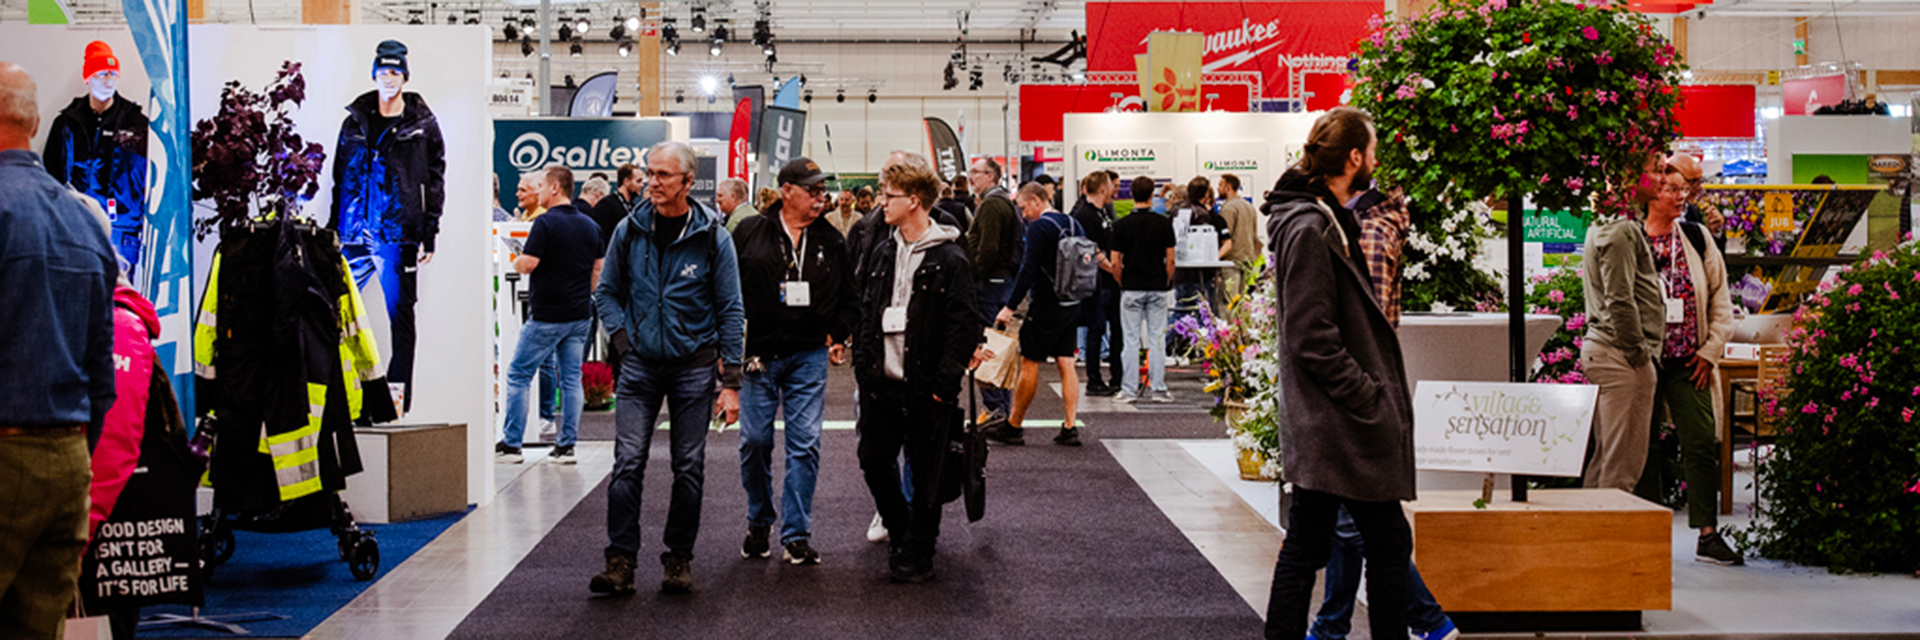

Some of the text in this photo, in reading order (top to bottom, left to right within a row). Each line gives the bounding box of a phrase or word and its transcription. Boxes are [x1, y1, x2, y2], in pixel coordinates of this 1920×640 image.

[551, 138, 649, 168] saltex
[1097, 149, 1155, 158] LIMONTA
[1522, 215, 1561, 228] ATURAL
[1770, 217, 1789, 228] JUB
[1527, 228, 1577, 239] ARTIFICIAL
[1445, 413, 1547, 445] sensation
[137, 518, 185, 538] DESIGN
[137, 538, 165, 556] FOR
[96, 562, 109, 579] A
[111, 557, 172, 577] GALLERY
[98, 575, 189, 598] IT'S FOR LIFE
